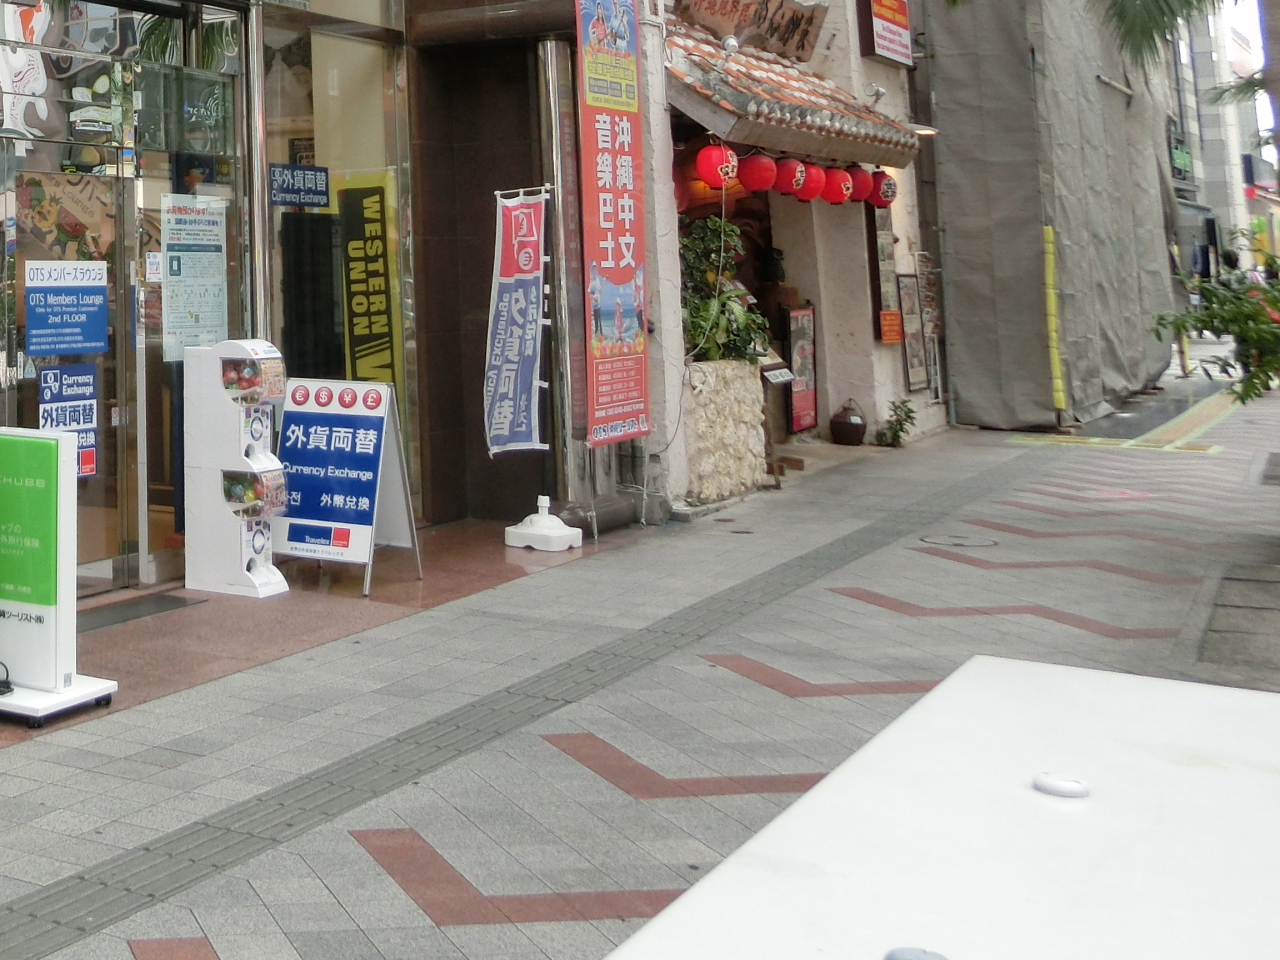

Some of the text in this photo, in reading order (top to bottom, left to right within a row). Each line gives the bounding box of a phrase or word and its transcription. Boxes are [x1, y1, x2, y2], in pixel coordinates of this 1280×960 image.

[283, 170, 327, 192] 外貨両替
[271, 190, 328, 206] Currency Exchange
[594, 112, 616, 269] 音樂巴士
[362, 193, 390, 335] WESTERN
[28, 267, 104, 281] OTS メンバーズラウンジ
[347, 240, 370, 336] UNION
[29, 292, 104, 305] OTS Members Lounge
[48, 313, 87, 323] 2nd FLOOR
[62, 374, 93, 385] Currency
[63, 385, 93, 396] Exchange
[41, 403, 95, 429] 外貨両替
[285, 424, 378, 454] 外貨両替
[282, 462, 374, 480] Currency Exchange
[287, 491, 301, 506] 전
